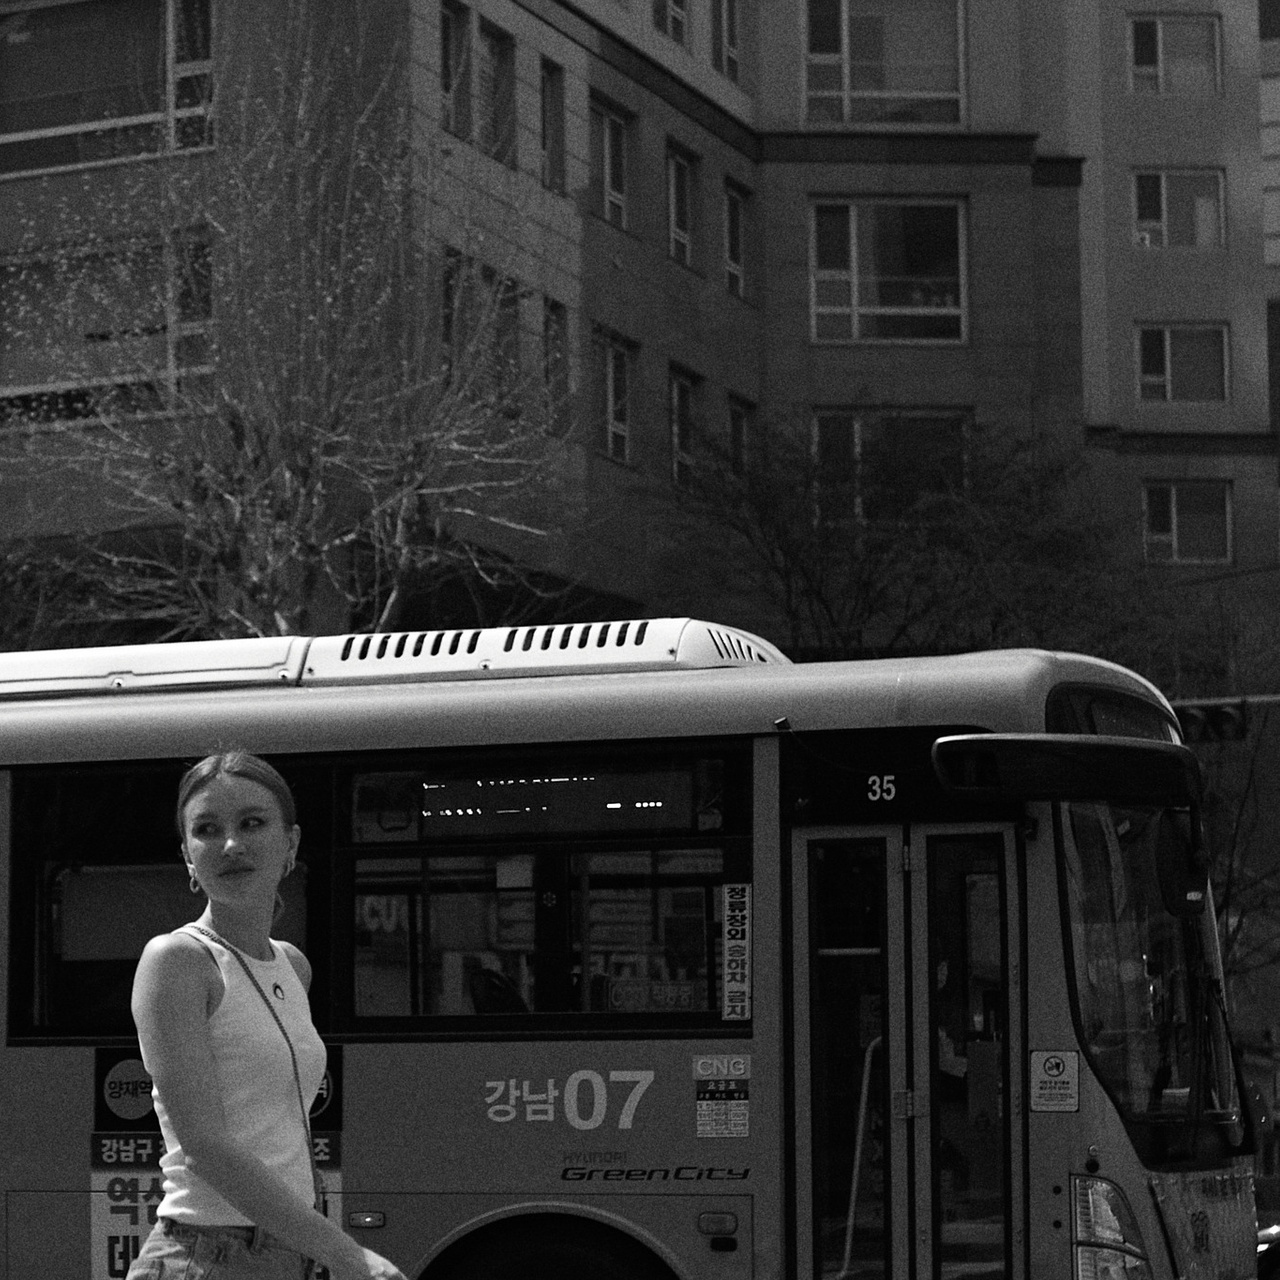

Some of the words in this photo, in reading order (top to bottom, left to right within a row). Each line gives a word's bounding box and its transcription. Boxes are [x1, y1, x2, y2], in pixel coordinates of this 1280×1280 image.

[867, 774, 896, 801] 35
[726, 990, 746, 1017] 금지
[696, 1058, 746, 1076] CNG
[107, 1080, 153, 1099] 양재역
[101, 1138, 153, 1163] 강남구
[561, 1166, 670, 1181] Green
[673, 1166, 752, 1181] City
